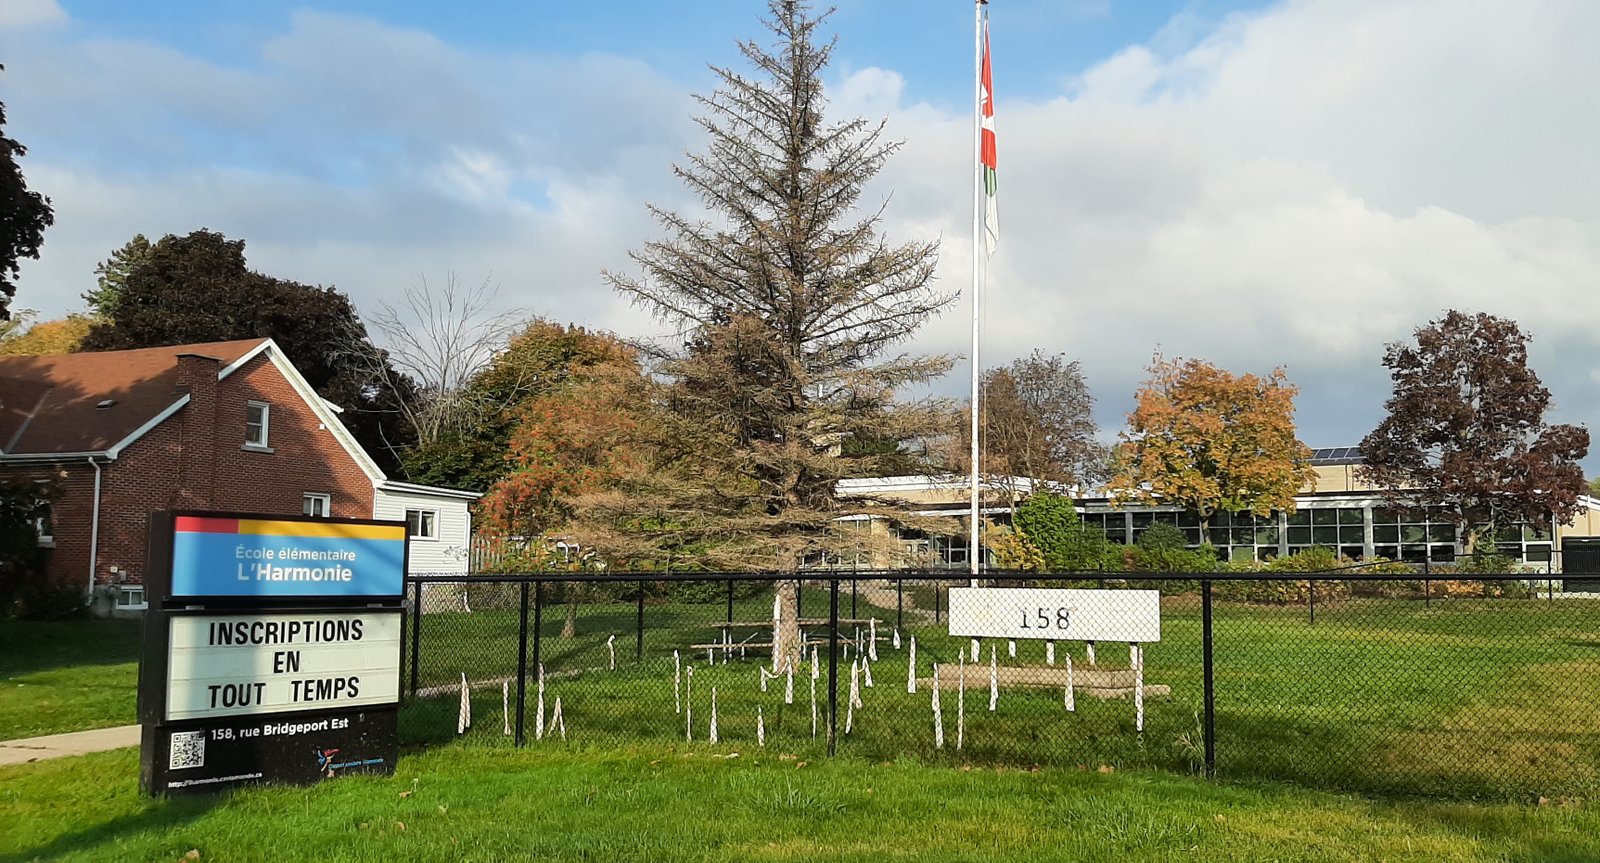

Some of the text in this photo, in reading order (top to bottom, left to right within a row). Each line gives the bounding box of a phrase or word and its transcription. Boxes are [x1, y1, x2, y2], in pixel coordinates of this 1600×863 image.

[236, 543, 356, 562] École élémentaire
[237, 563, 352, 582] L'Harmonie
[1020, 607, 1070, 630] 158
[209, 619, 363, 646] INSCRIPTIONS
[273, 650, 300, 673] EN
[208, 676, 360, 708] TOUT TEMPS
[211, 717, 349, 741] 158, rue Bridgeport Est
